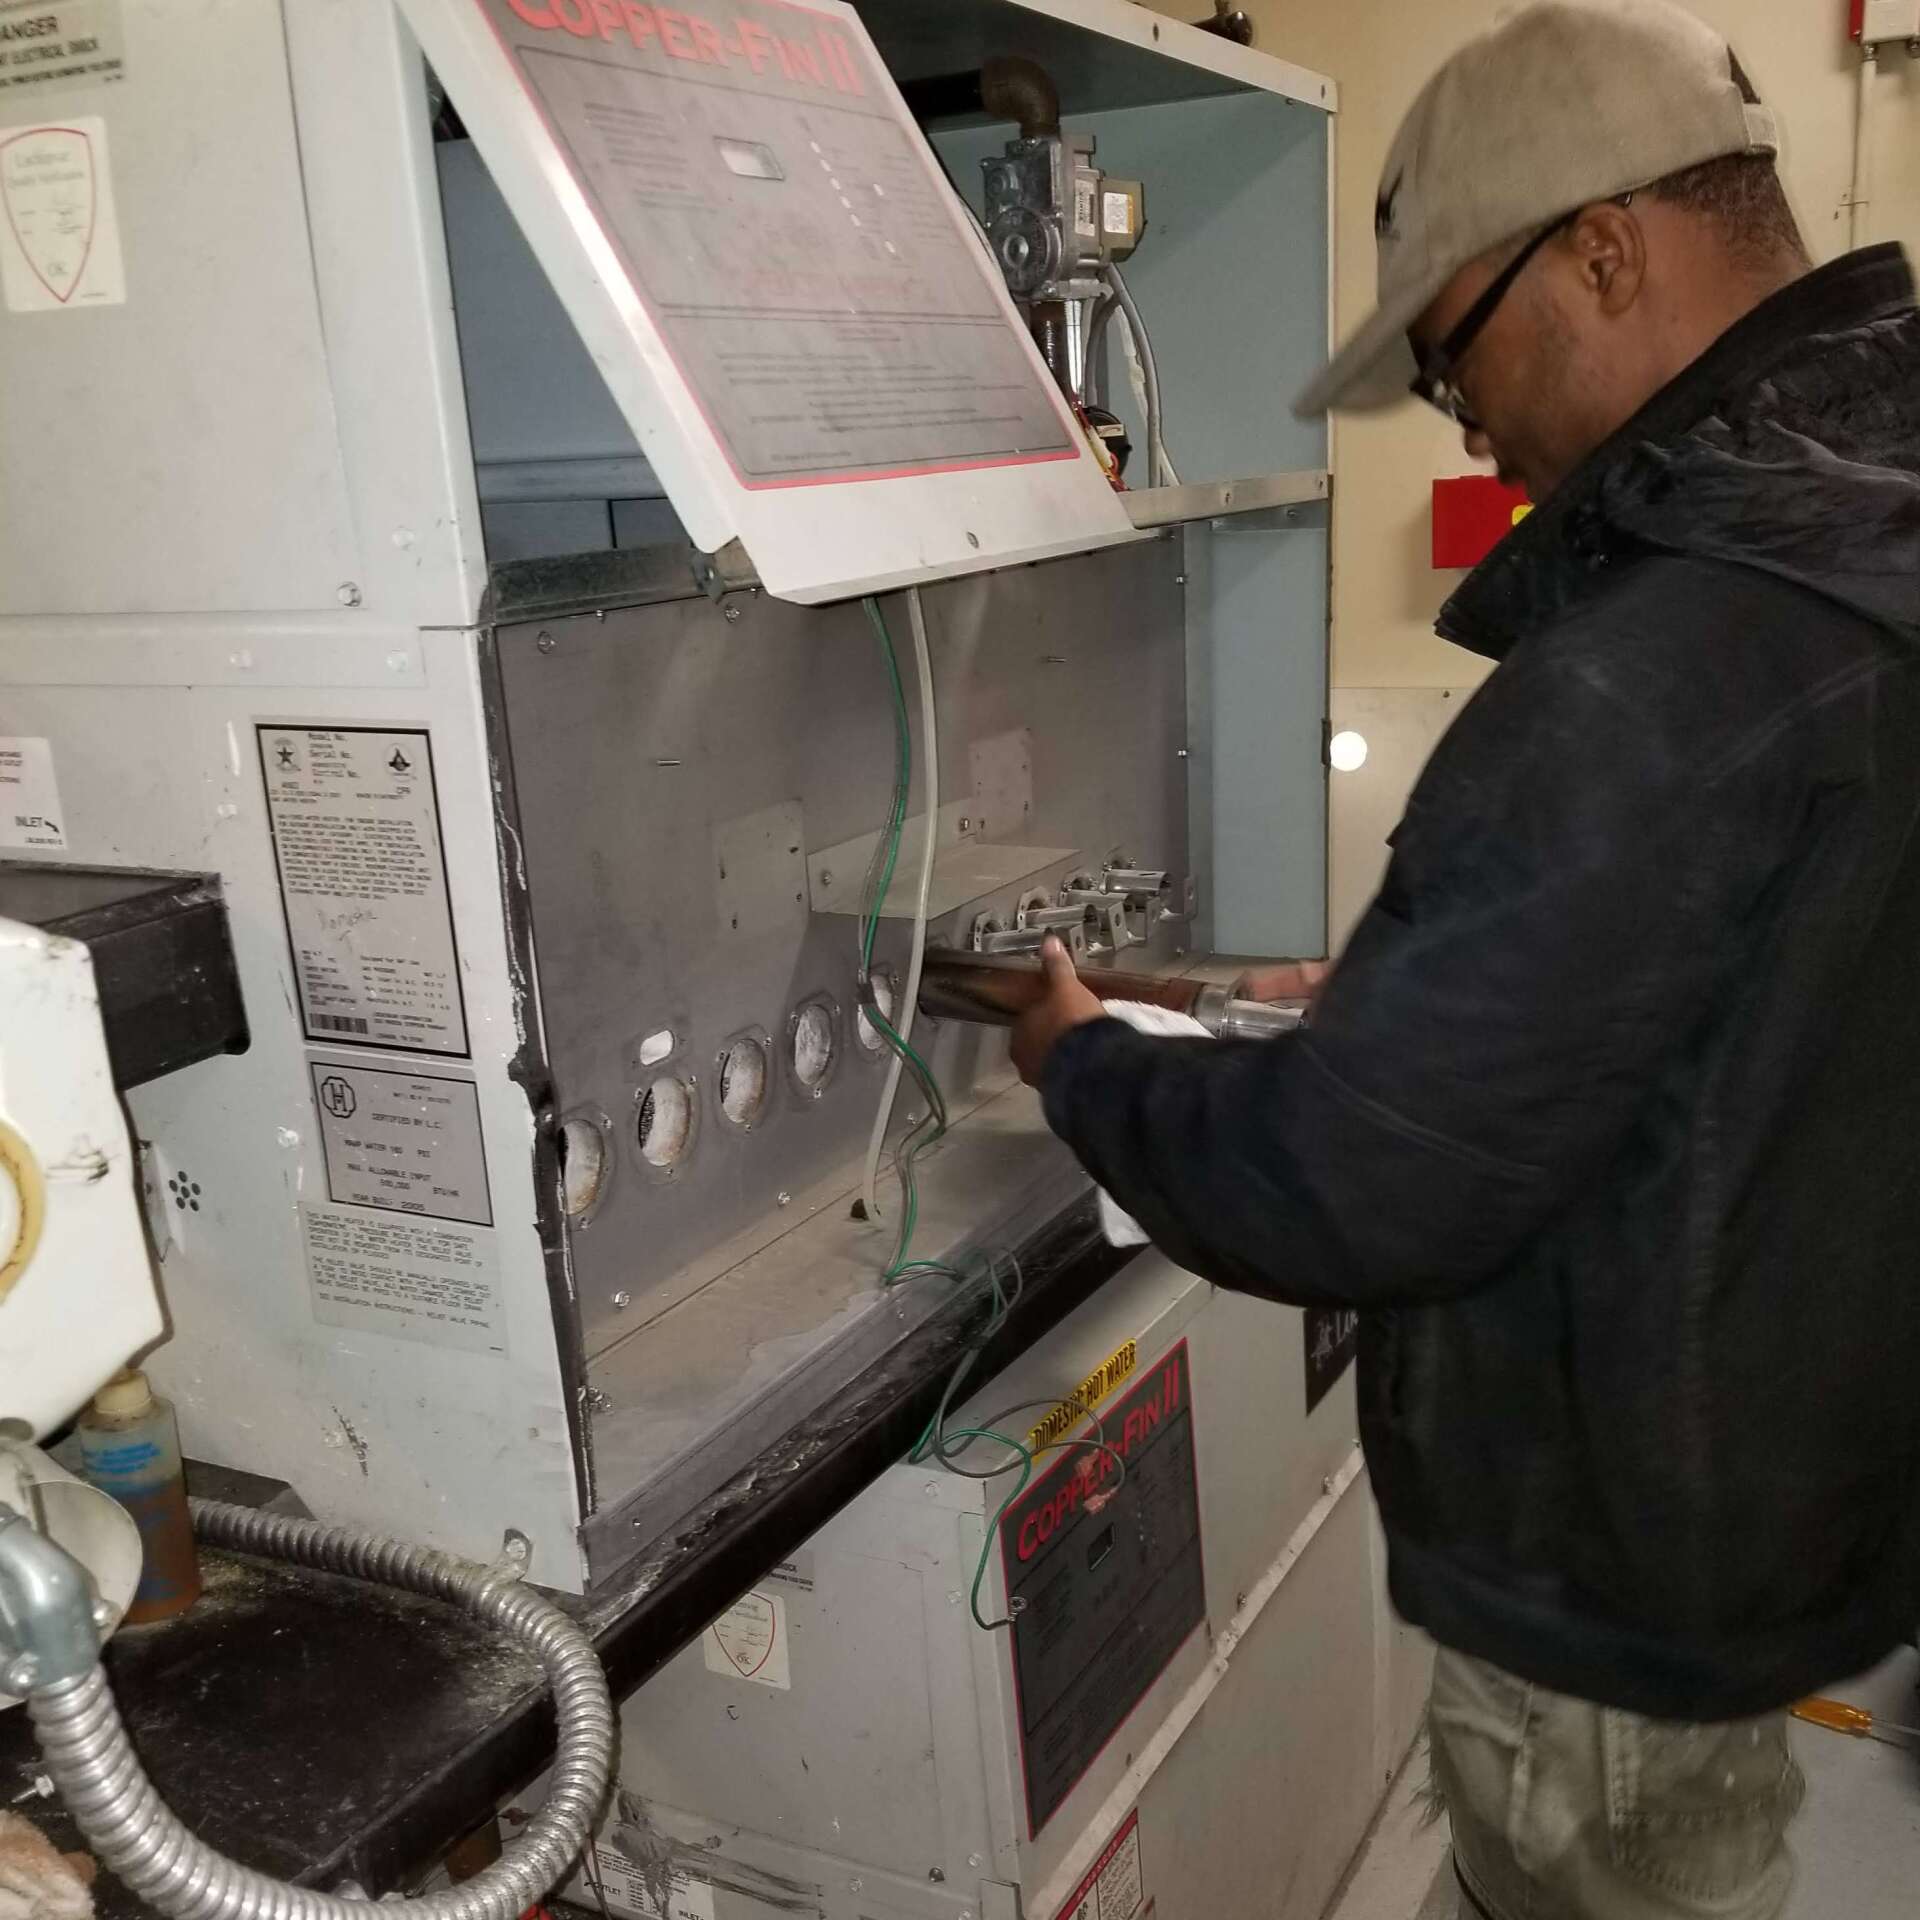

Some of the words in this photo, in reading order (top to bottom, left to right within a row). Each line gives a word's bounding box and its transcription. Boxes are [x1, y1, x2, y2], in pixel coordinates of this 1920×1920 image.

[1034, 1388, 1085, 1450] DOMESTIC
[1086, 1369, 1104, 1408] HOT
[1104, 1342, 1136, 1388] WATER
